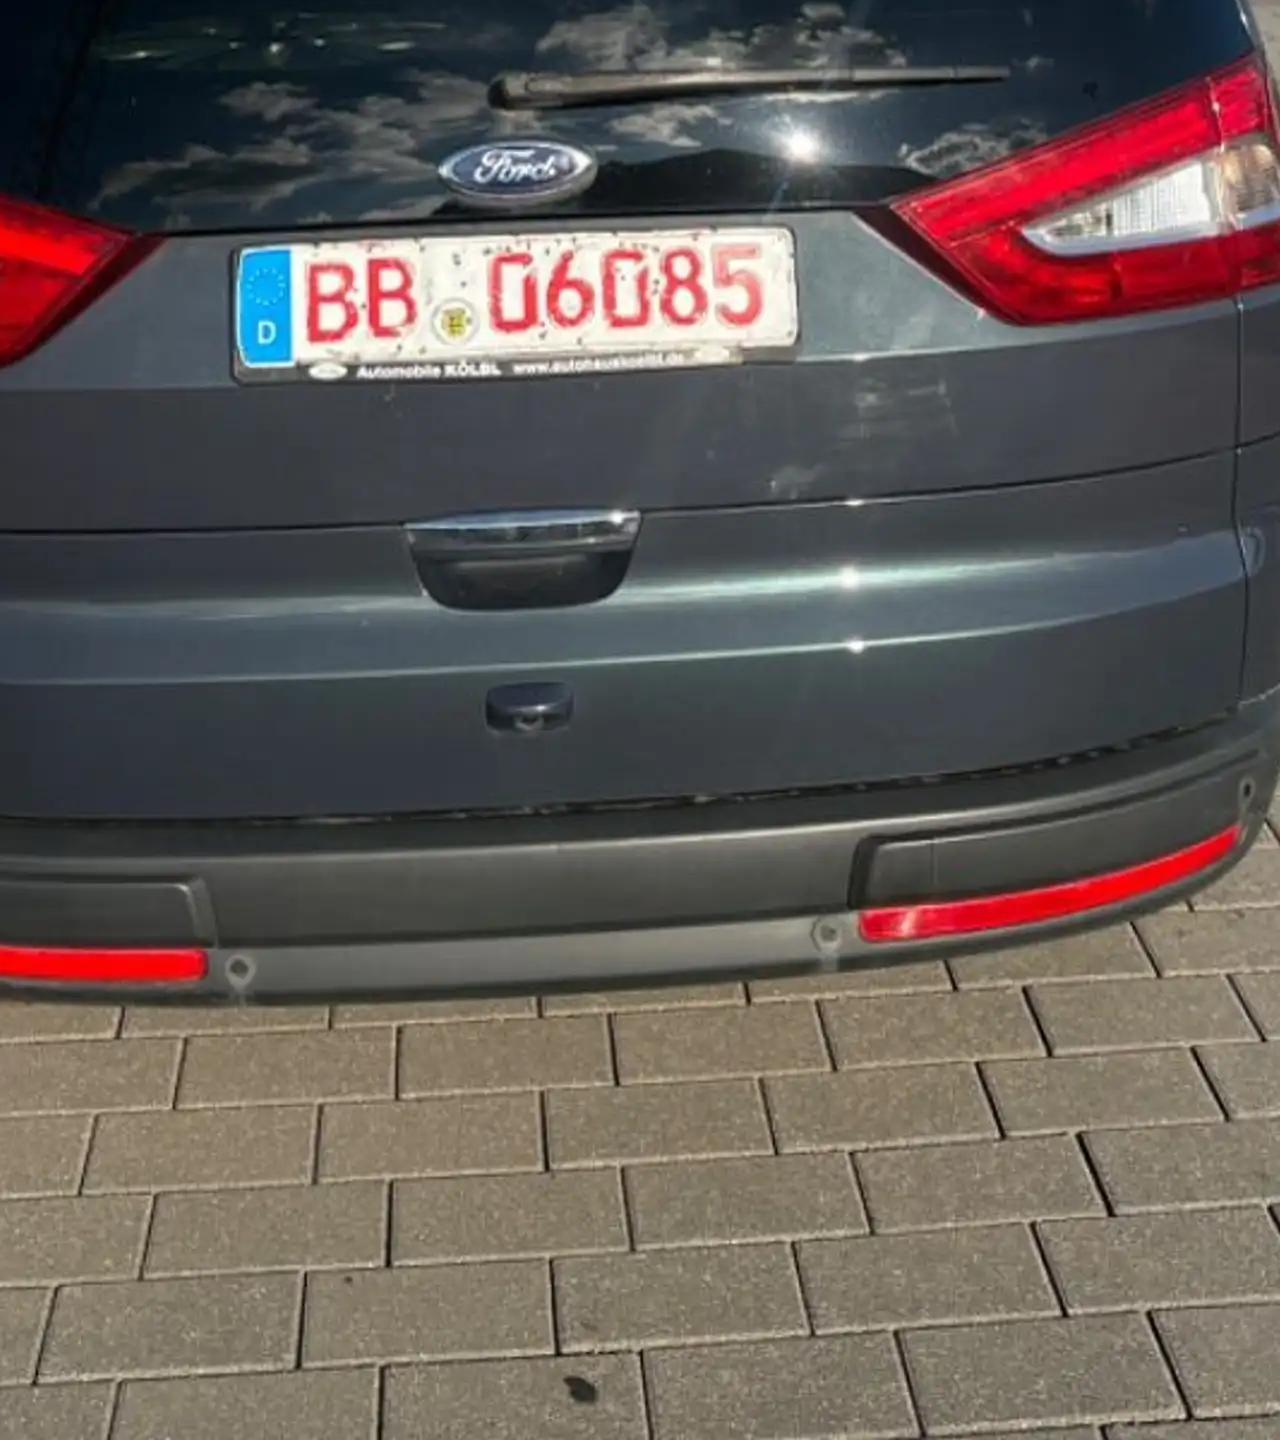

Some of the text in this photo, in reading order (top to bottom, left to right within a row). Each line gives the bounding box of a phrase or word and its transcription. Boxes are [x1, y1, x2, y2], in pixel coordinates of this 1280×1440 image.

[473, 149, 557, 184] Ford
[304, 243, 763, 344] BB 06085
[257, 320, 276, 344] D
[356, 364, 441, 379] Automobile
